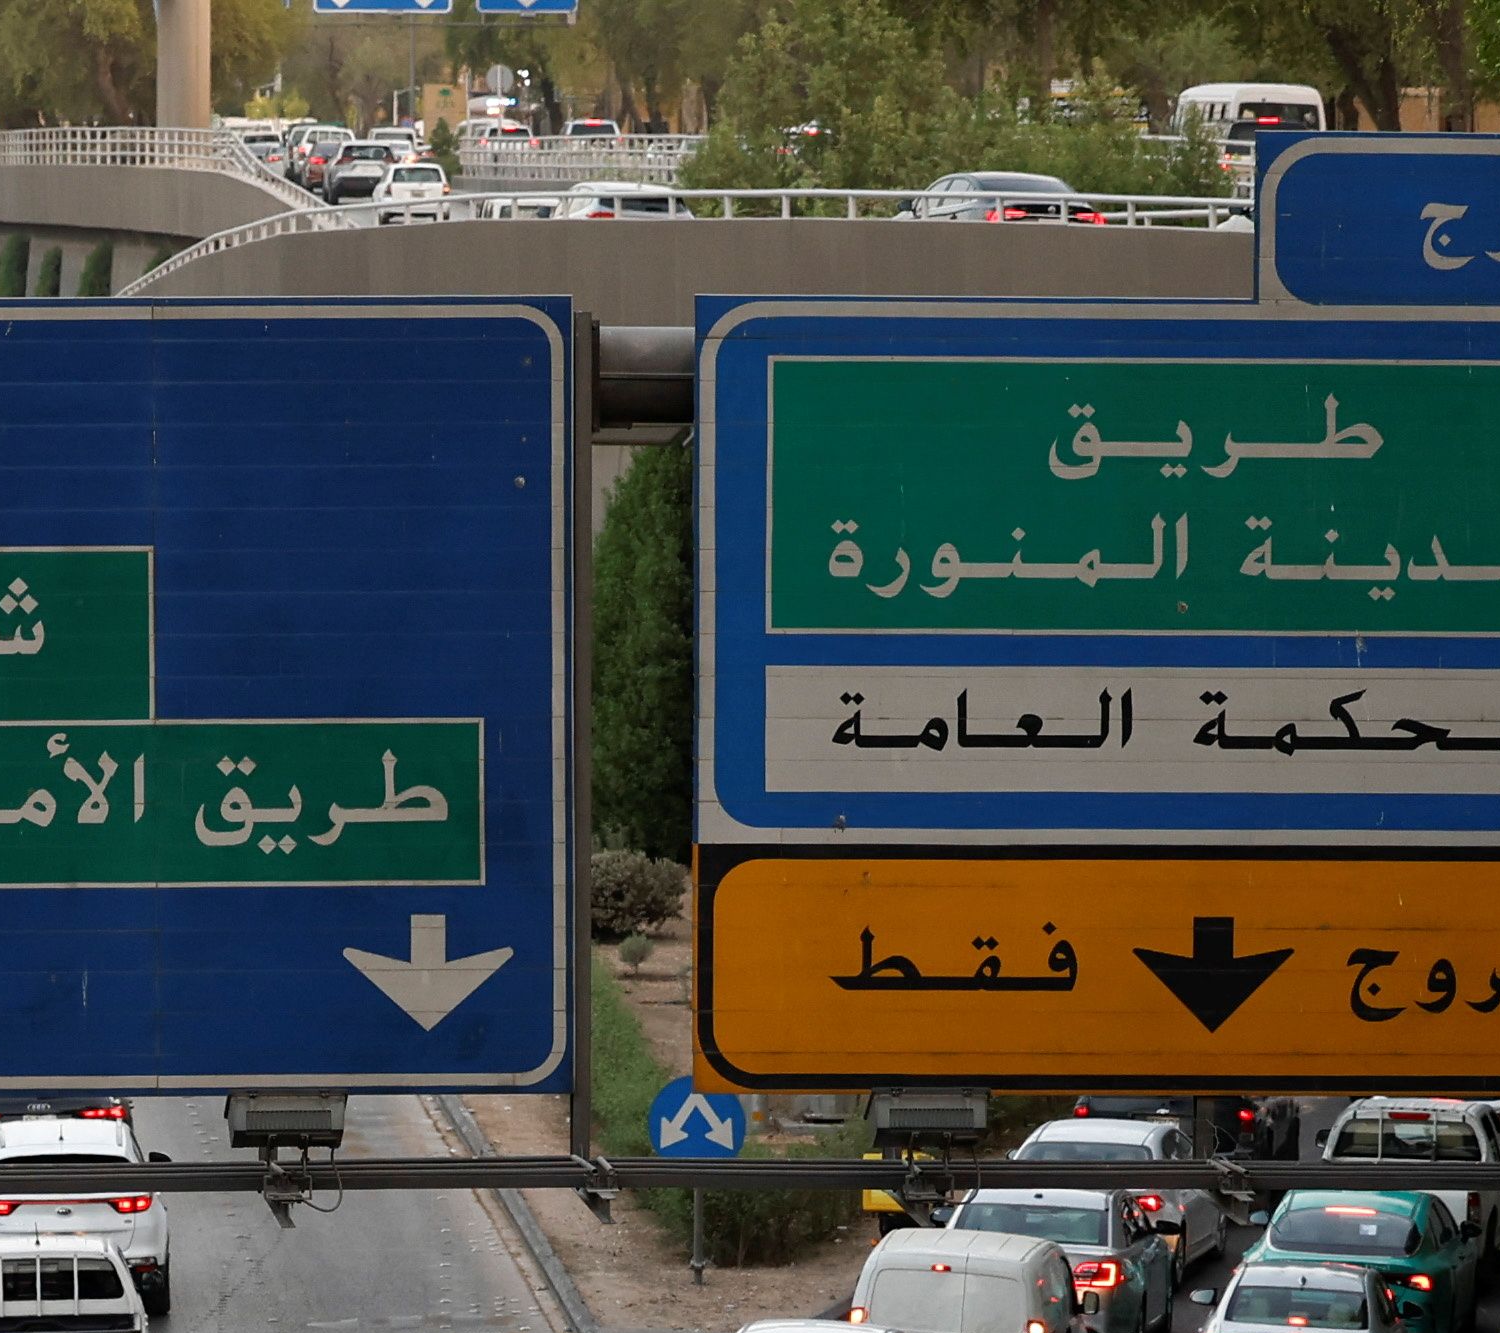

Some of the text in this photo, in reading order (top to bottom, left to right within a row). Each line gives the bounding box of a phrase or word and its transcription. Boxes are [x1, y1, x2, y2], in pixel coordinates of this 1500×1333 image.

[1050, 394, 1383, 479] طريق
[830, 514, 1187, 599] المنورة
[832, 687, 1133, 751] العامة
[195, 750, 447, 853] طريق
[831, 922, 1077, 991] فقط
